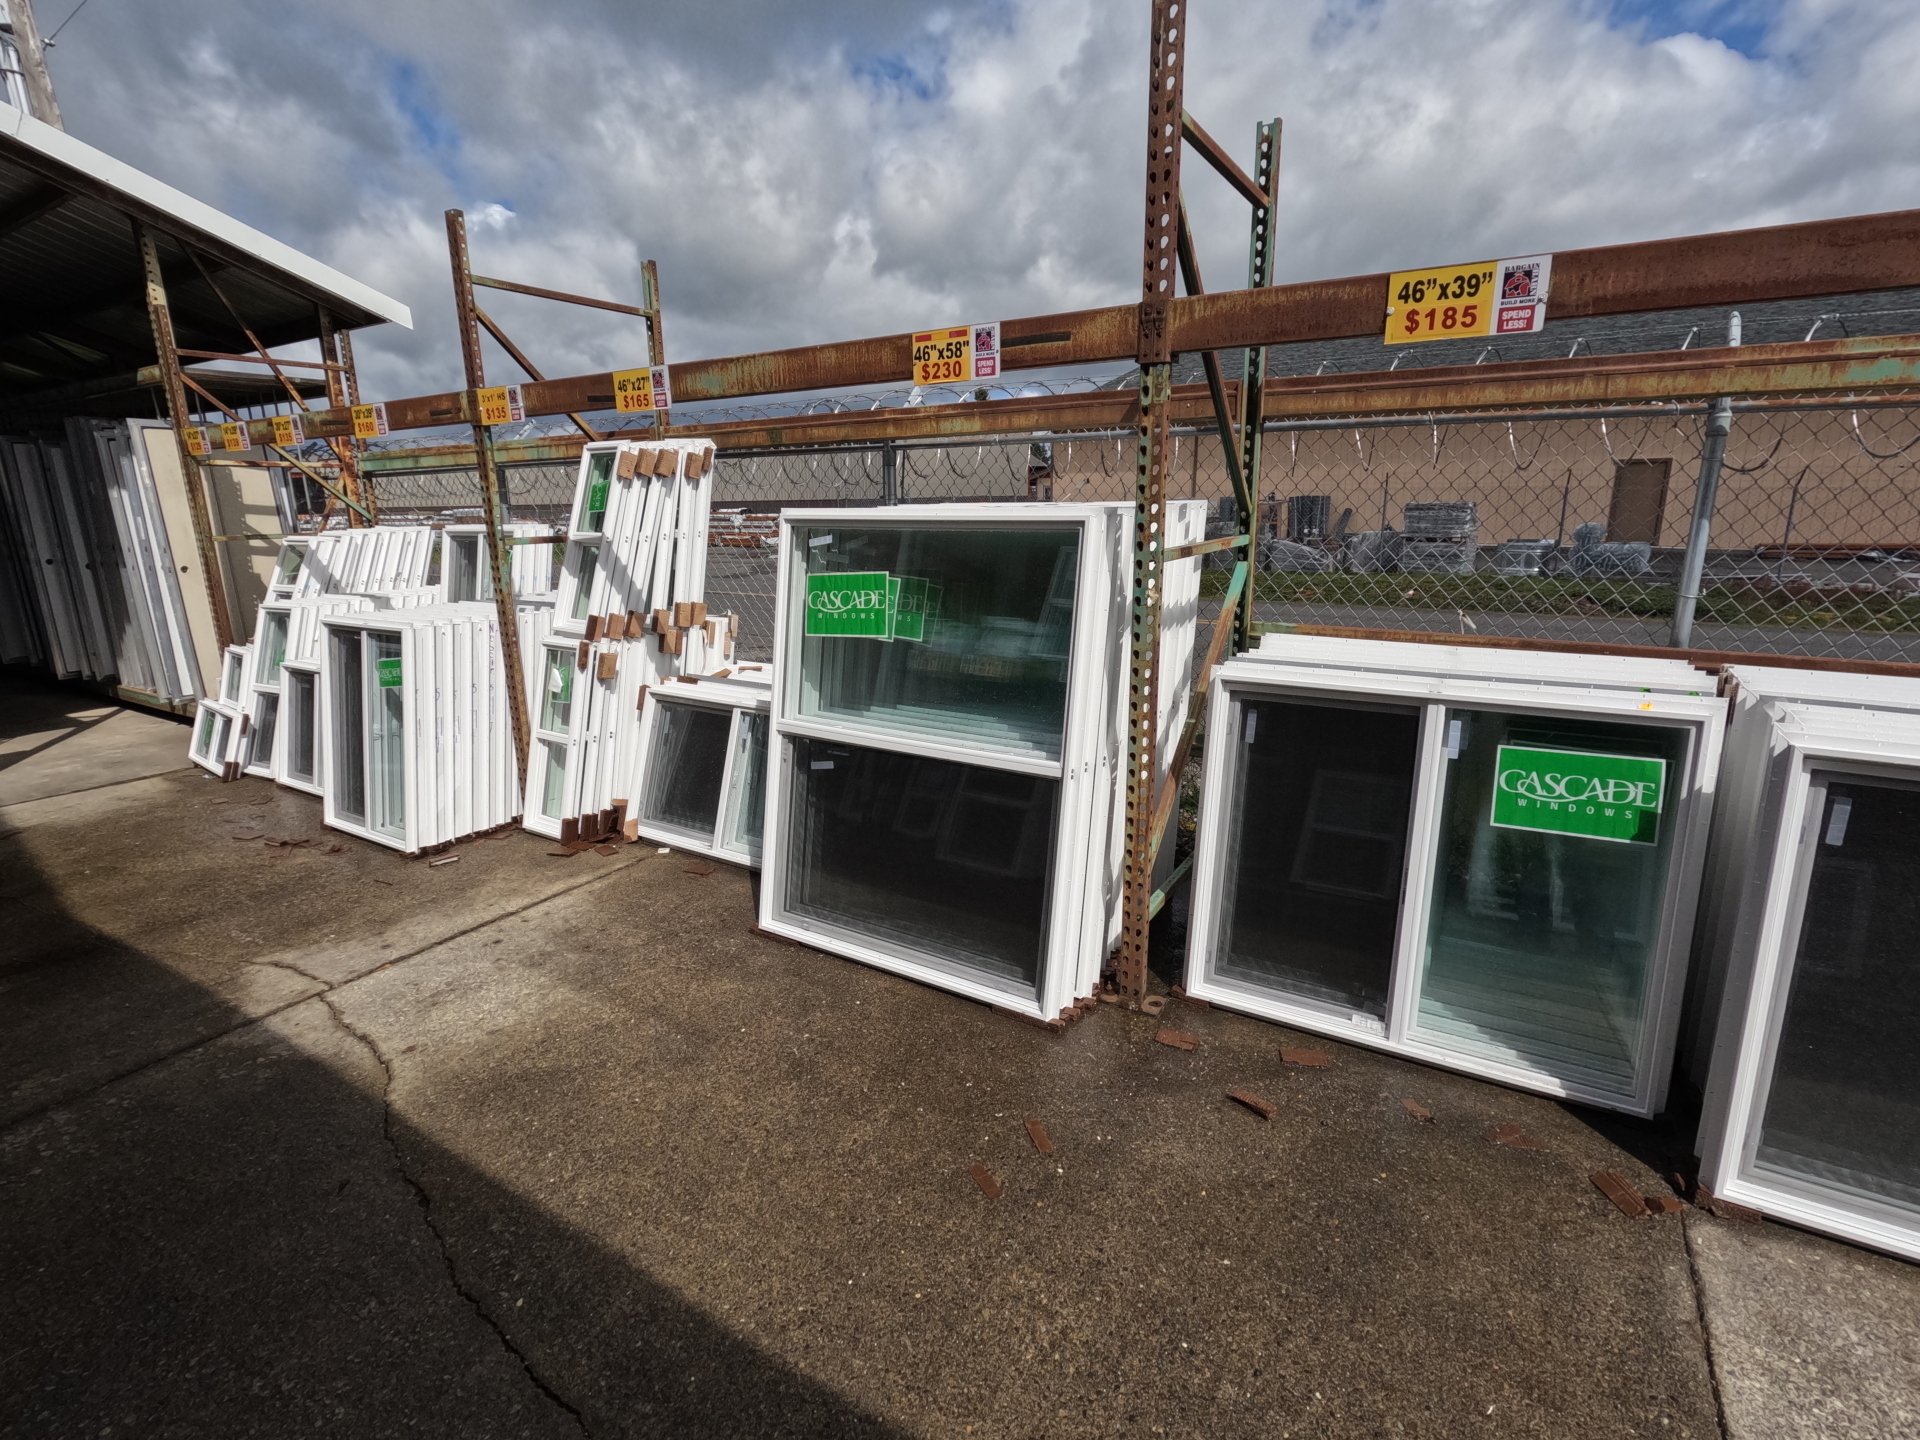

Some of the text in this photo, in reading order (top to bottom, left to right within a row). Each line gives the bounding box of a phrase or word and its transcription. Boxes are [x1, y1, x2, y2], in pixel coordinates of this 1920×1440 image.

[1404, 304, 1478, 335] $185
[1502, 309, 1532, 320] SPEND
[1503, 319, 1528, 330] LESS!
[914, 340, 970, 362] 46"x58"
[922, 360, 962, 382] $230
[617, 376, 650, 392] 46"x27"
[623, 394, 650, 409] $165
[486, 406, 507, 421] $135
[358, 422, 374, 433] $160
[808, 590, 886, 613] CASCADE
[1499, 769, 1658, 808] CASCADE
[1517, 797, 1633, 819] WINDOWS
